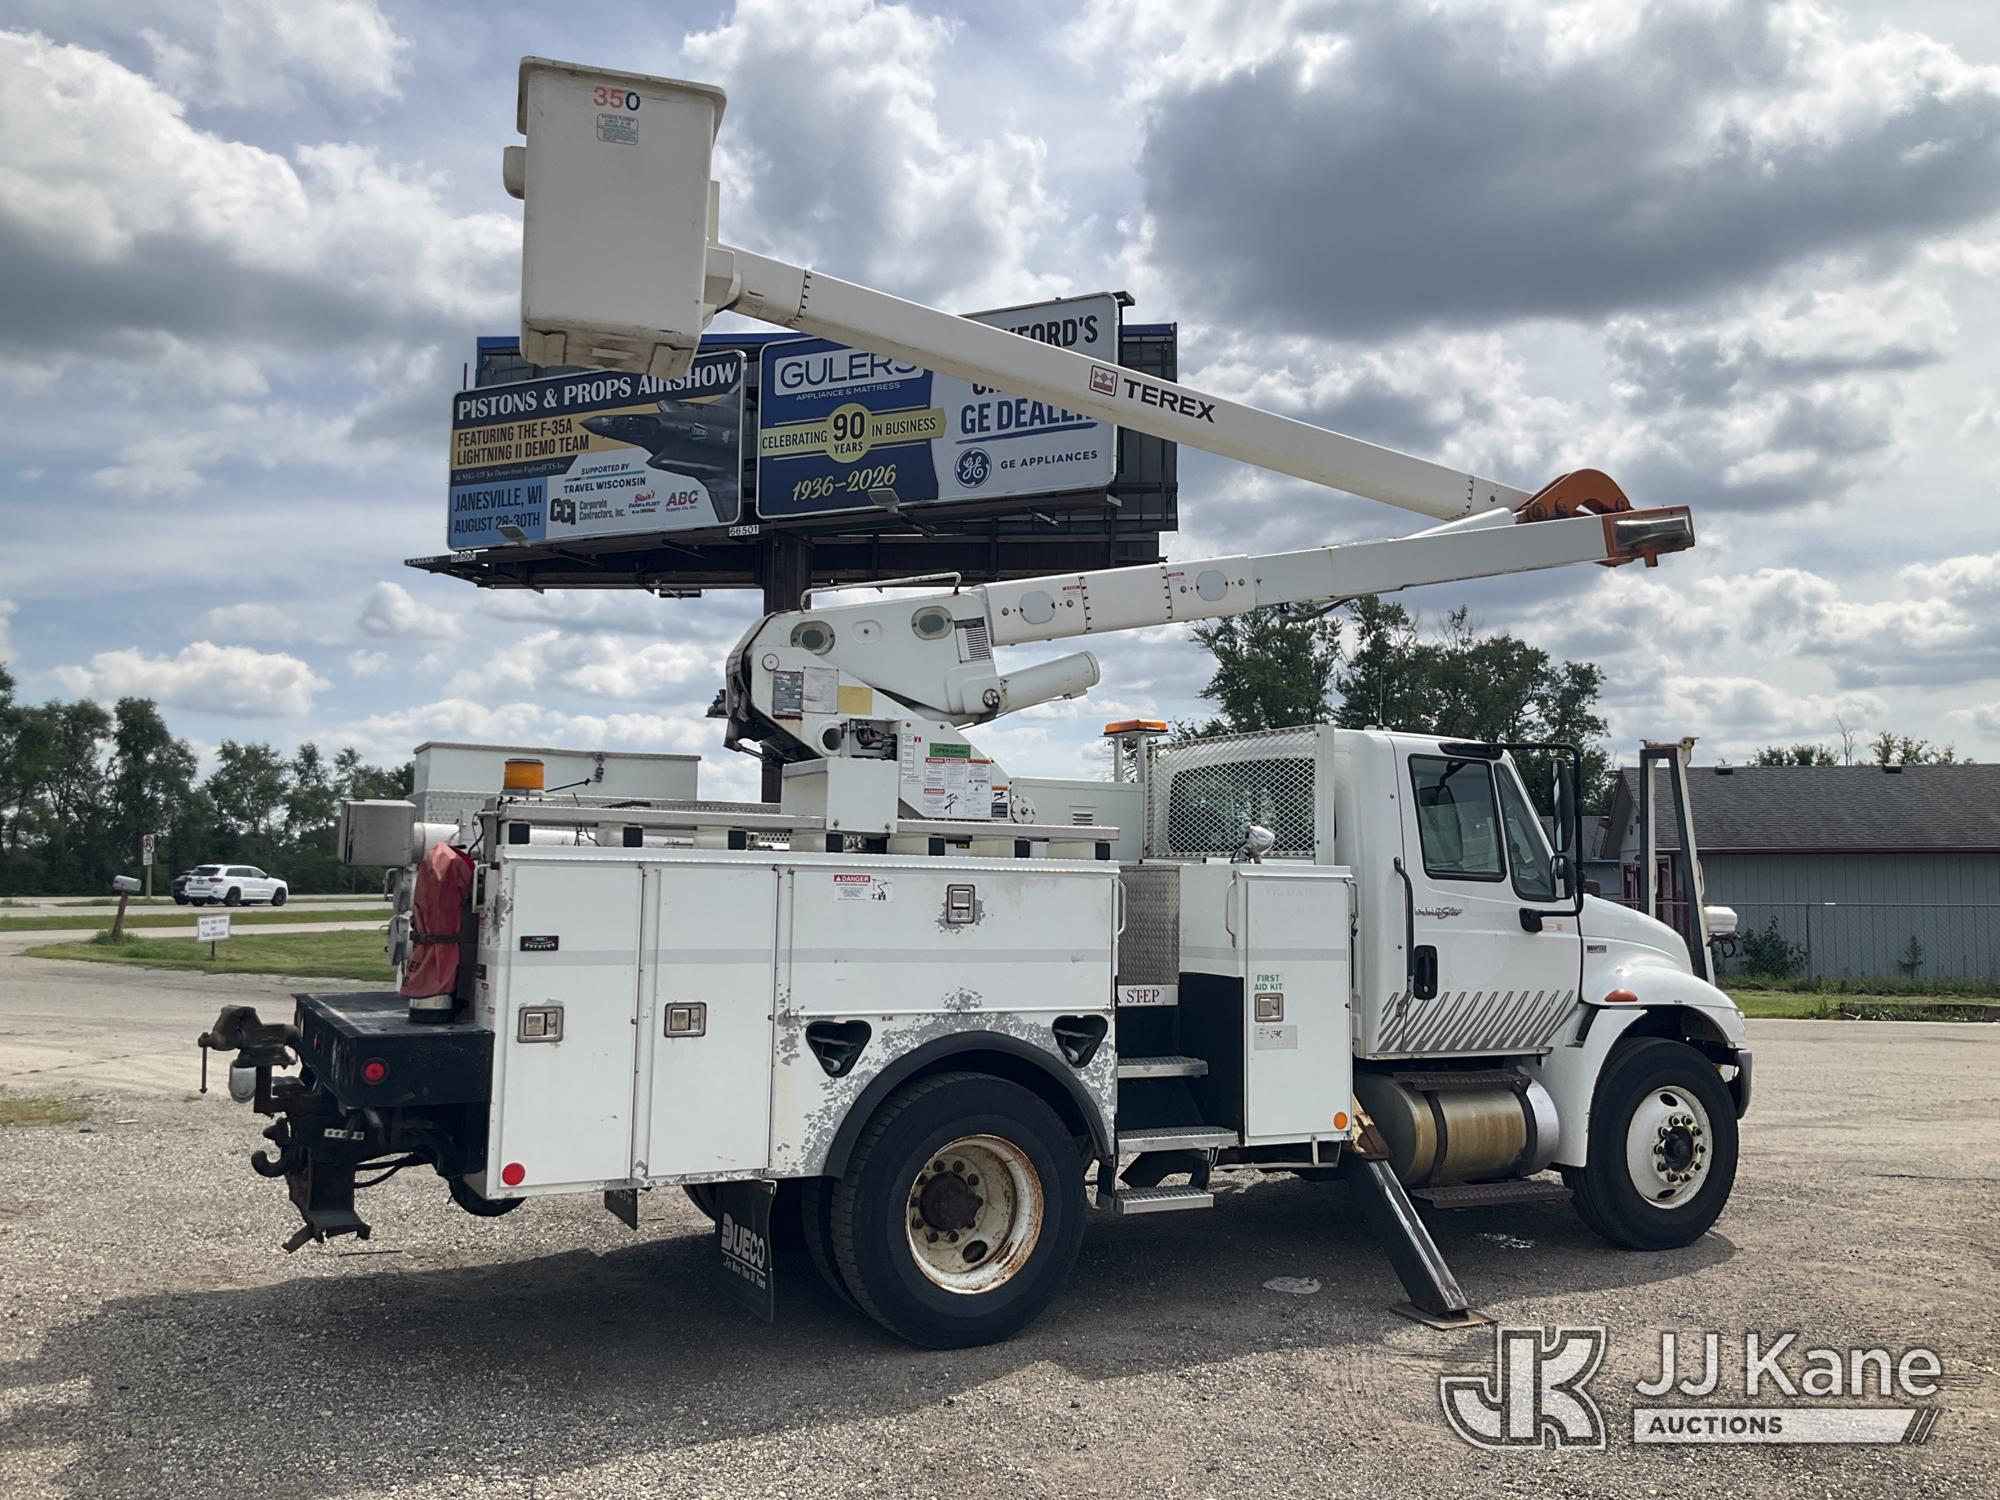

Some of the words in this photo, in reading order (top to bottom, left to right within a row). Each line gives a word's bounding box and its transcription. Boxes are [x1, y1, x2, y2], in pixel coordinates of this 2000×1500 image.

[593, 86, 641, 111] 350
[458, 391, 537, 420] PISTONS
[543, 388, 558, 408] &
[564, 377, 632, 405] PROPS
[796, 389, 844, 401] APPLIANCE
[845, 387, 852, 395] &
[853, 382, 900, 393] MATTRESS
[1124, 378, 1216, 424] TEREX
[833, 411, 865, 441] 90
[961, 403, 991, 434] GE
[458, 426, 514, 447] FEATURING
[517, 423, 537, 440] THE
[541, 418, 572, 437] F-35A
[762, 430, 828, 449] CELEBRATING
[872, 424, 882, 436] IN
[886, 417, 936, 435] BUSINESS
[457, 444, 512, 465] LIGHTNING
[515, 443, 522, 458] II
[525, 439, 555, 457] DEMO
[559, 434, 589, 453] TEAM
[834, 441, 863, 454] YEARS
[1001, 459, 1016, 469] GE
[1020, 450, 1098, 467] APPLIANCES
[581, 465, 619, 475] SUPPORTED
[564, 483, 595, 494] TRAVEL
[596, 477, 646, 491] WISCONSIN
[793, 463, 897, 501] 1936-2026
[454, 487, 524, 513] JANESVILLE,
[527, 485, 542, 505] WI
[580, 499, 607, 510] Corporate
[666, 490, 698, 506] ABC
[615, 508, 625, 517] Inc.
[454, 516, 493, 534] AUGUST
[496, 512, 540, 531] 28-30TH
[731, 525, 757, 536] 66501
[1254, 983, 1268, 991] AID
[1270, 983, 1283, 991] KIT
[1257, 974, 1280, 982] FIRST
[1126, 989, 1160, 1003] STEP
[721, 1212, 765, 1269] DUECO
